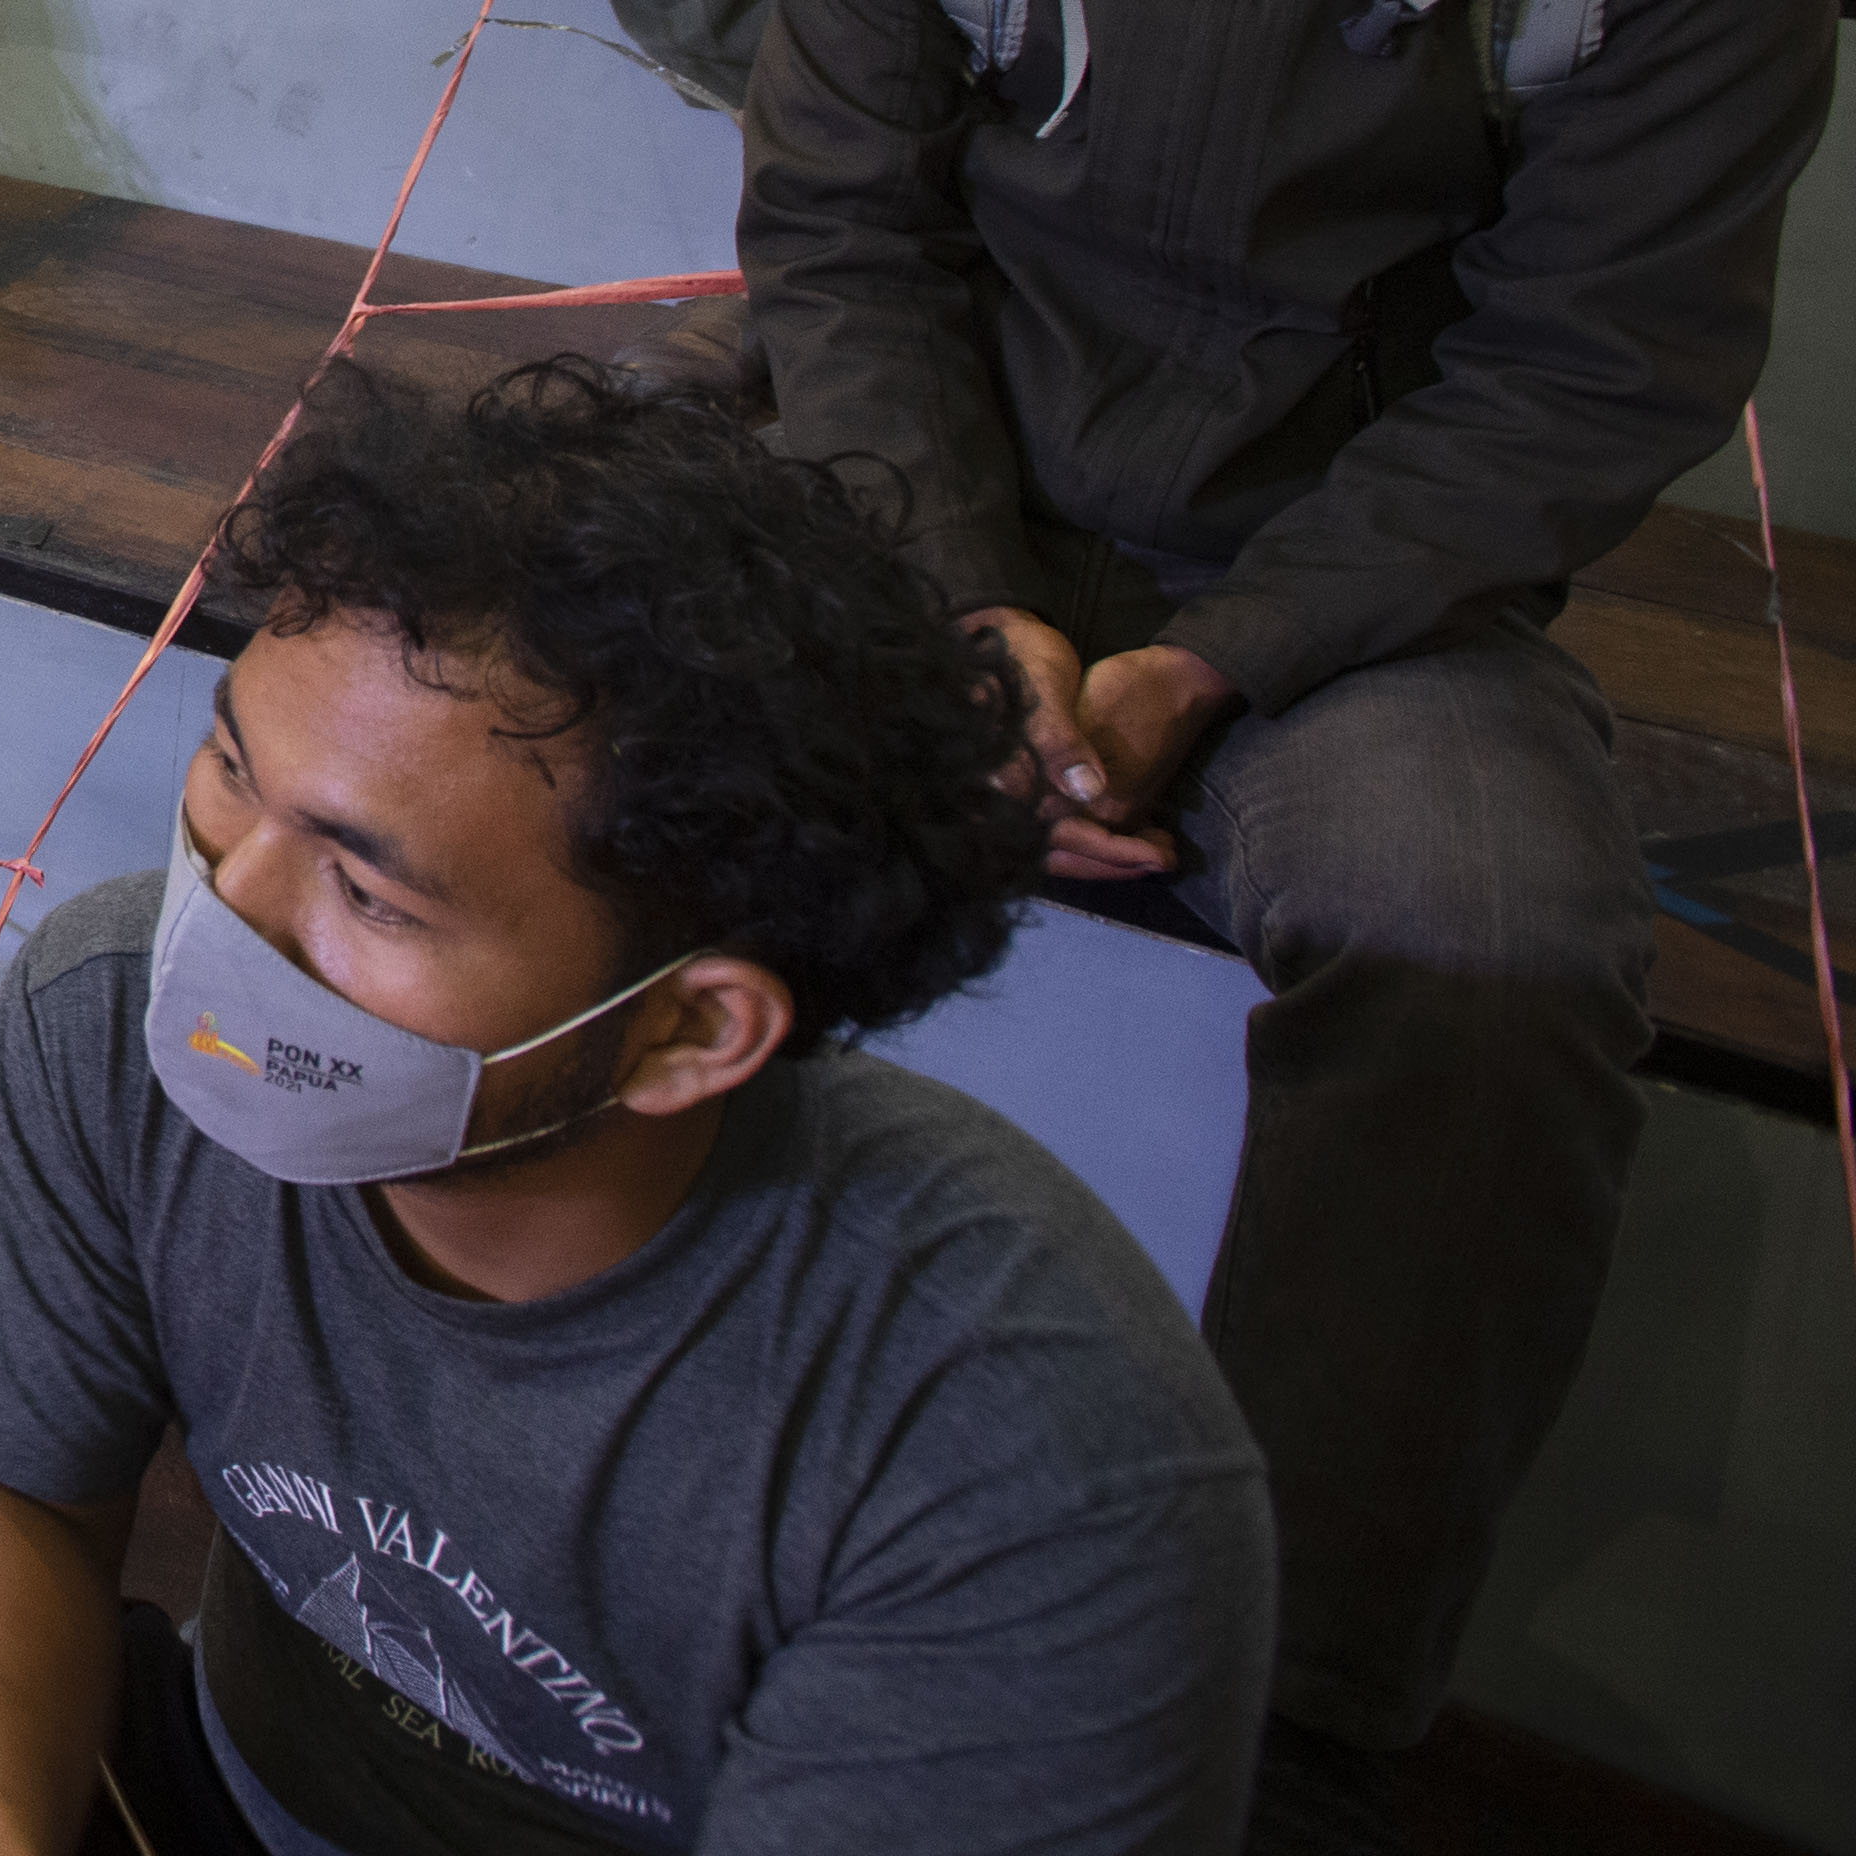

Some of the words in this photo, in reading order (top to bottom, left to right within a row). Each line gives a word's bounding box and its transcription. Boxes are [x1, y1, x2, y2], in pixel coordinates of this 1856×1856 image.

[265, 1059, 338, 1093] PAPUA
[267, 1036, 321, 1069] PON
[329, 1056, 364, 1081] XX
[263, 1071, 303, 1094] 2021
[221, 1461, 344, 1535] GIANNI
[354, 1495, 644, 1756] VALENTINO
[381, 1693, 442, 1750] SEA
